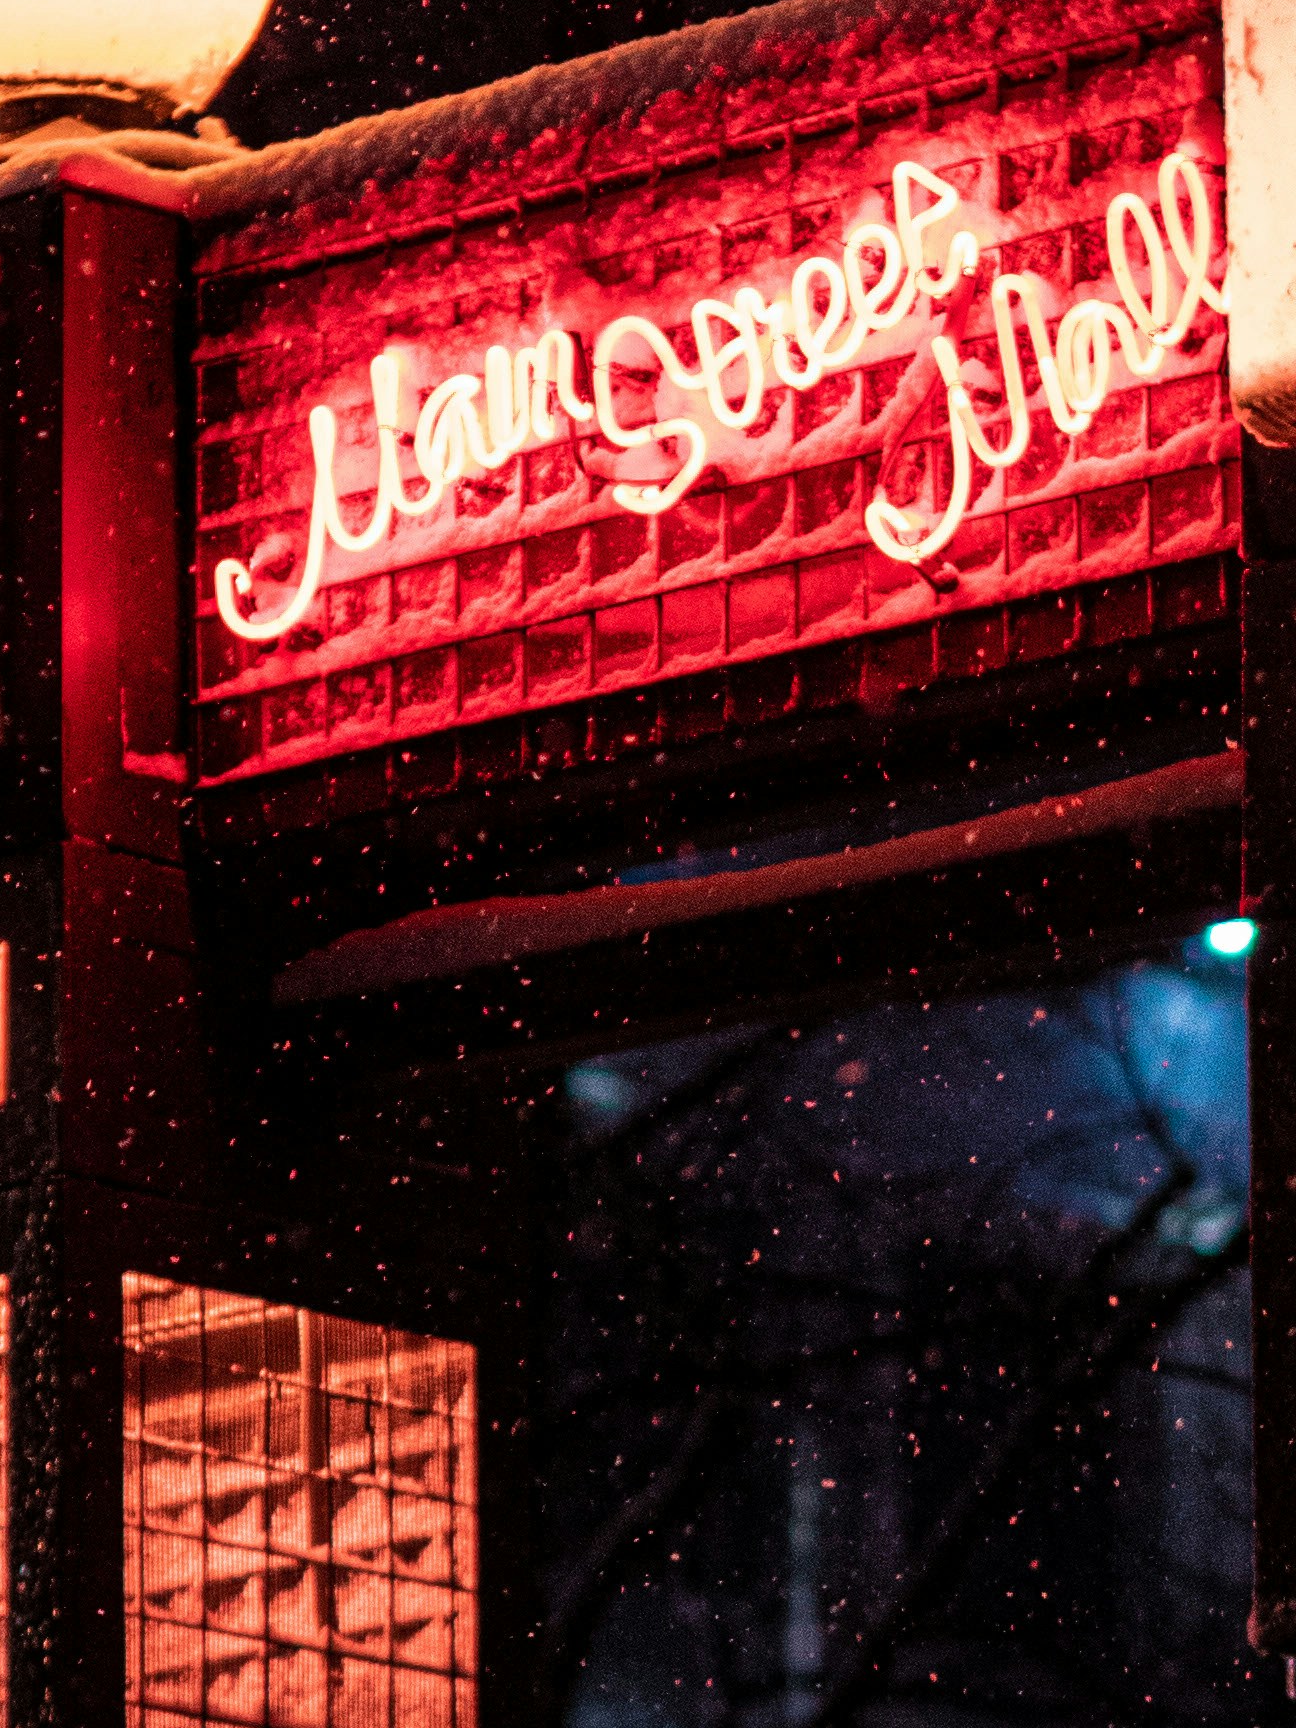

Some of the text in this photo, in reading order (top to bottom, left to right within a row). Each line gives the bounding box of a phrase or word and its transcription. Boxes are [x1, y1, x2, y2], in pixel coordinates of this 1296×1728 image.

[216, 152, 1232, 640] Main Street Mall
